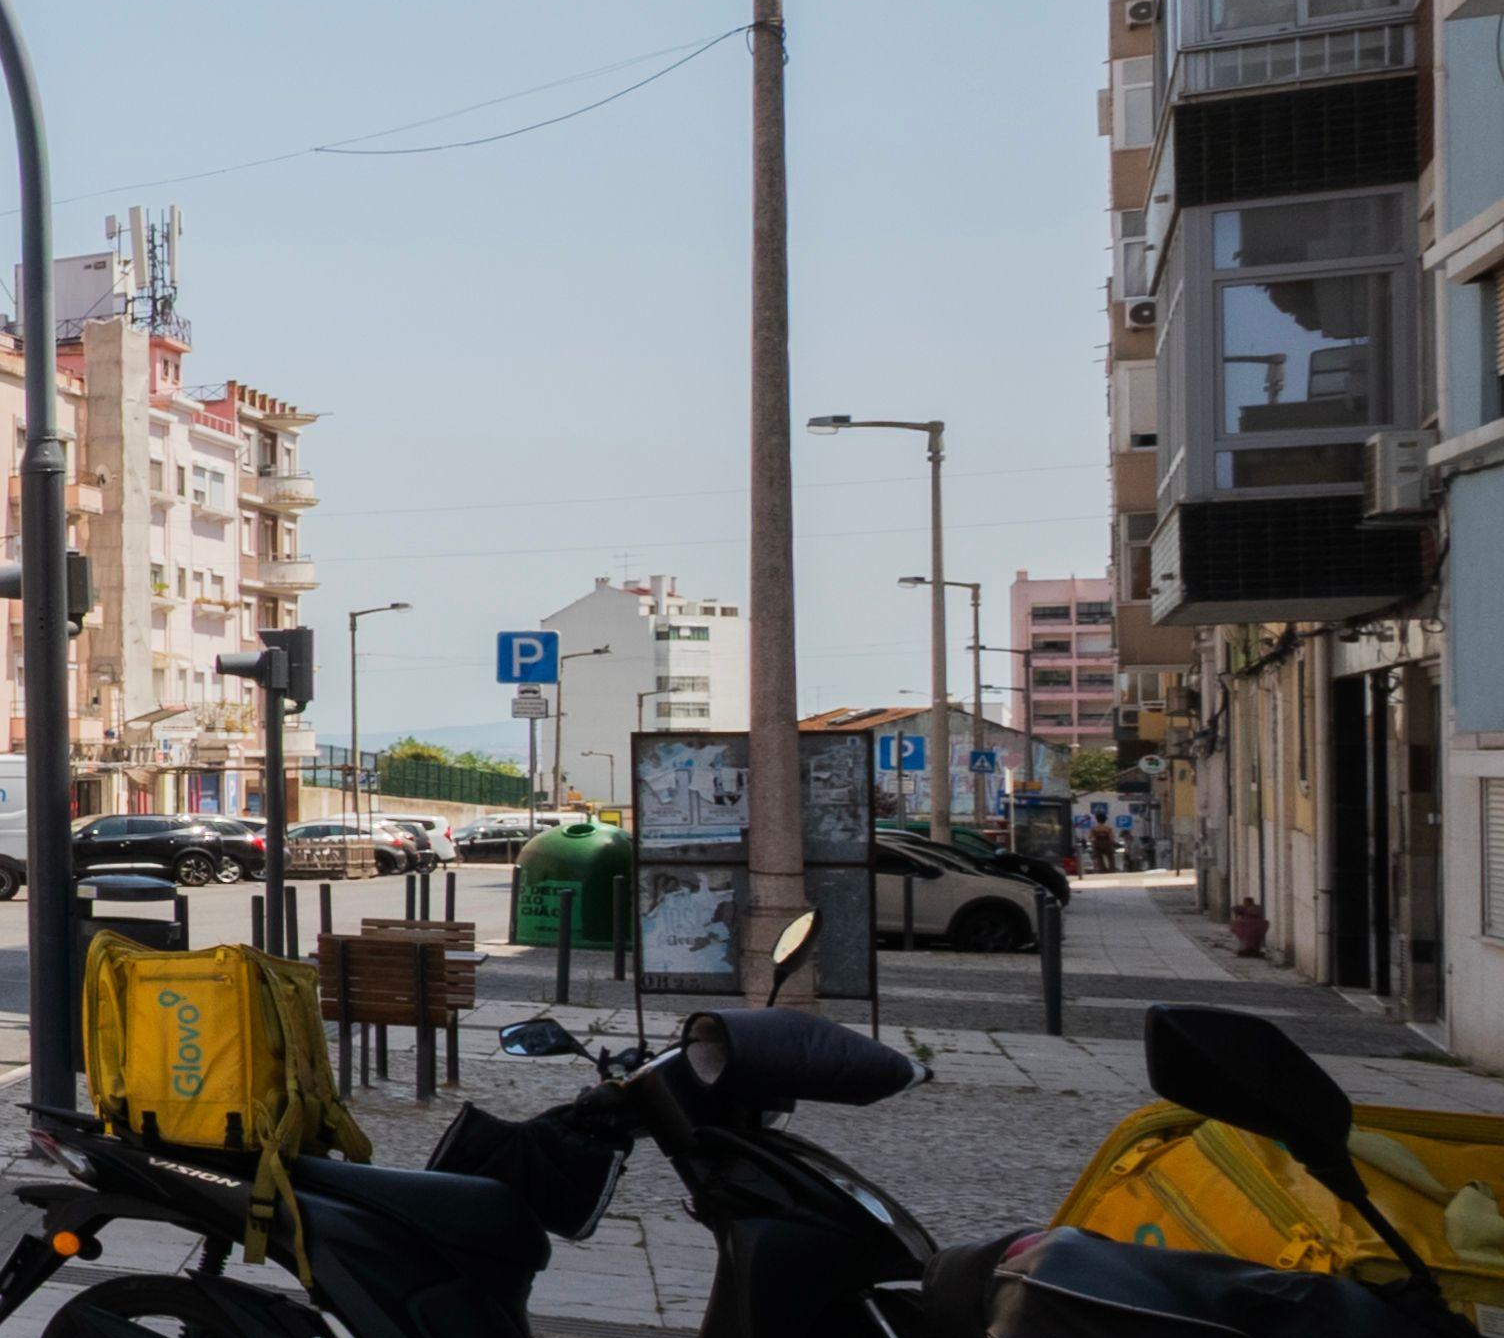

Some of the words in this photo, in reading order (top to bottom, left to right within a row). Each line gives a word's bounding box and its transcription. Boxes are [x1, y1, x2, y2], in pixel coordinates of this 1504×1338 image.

[512, 637, 544, 677] P
[890, 739, 914, 767] P
[172, 1004, 206, 1098] Glovo
[149, 1157, 241, 1188] VISION
